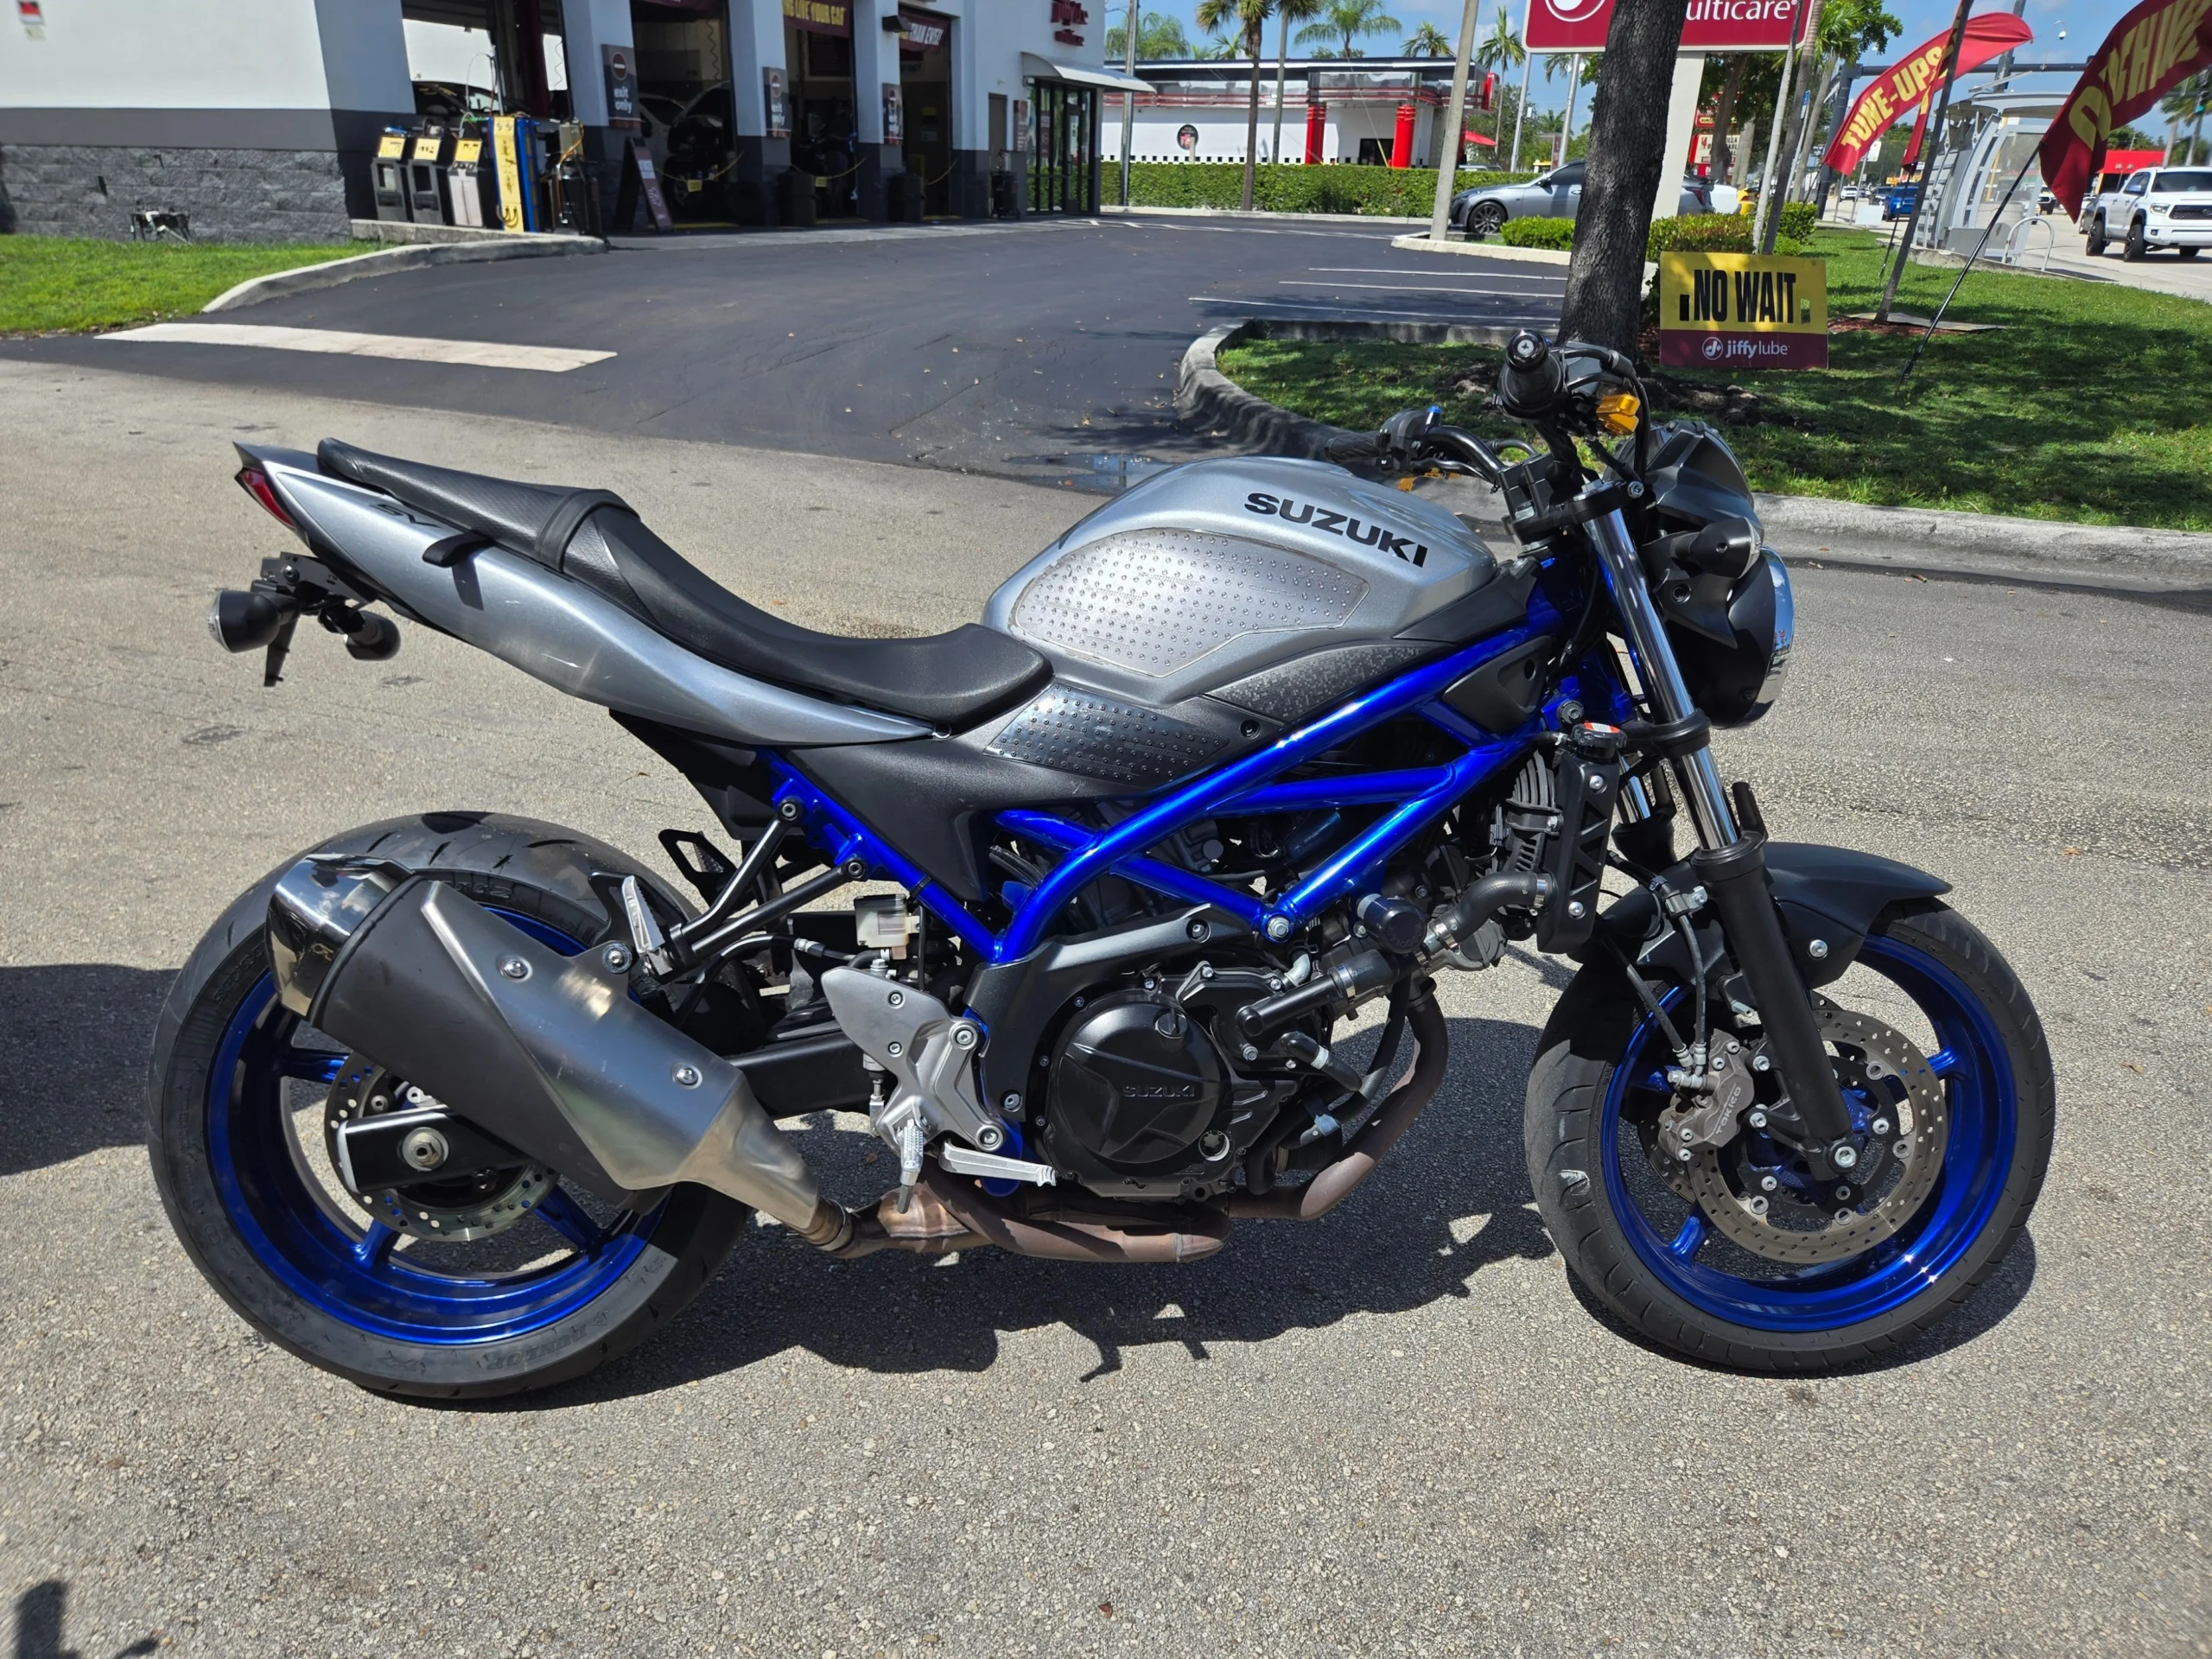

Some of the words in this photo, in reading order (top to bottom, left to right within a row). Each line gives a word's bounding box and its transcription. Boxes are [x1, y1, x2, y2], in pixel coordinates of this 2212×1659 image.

[1686, 0, 1791, 21] ulticare
[613, 86, 629, 99] exit
[614, 99, 632, 114] only
[1694, 270, 1727, 322] NO
[1735, 270, 1796, 324] WAIT
[1726, 340, 1757, 359] jiffy
[1758, 340, 1788, 355] lube
[1244, 493, 1428, 568] SUZUKI
[1123, 1085, 1195, 1097] SUZUKI
[1715, 1086, 1742, 1135] TOKICO
